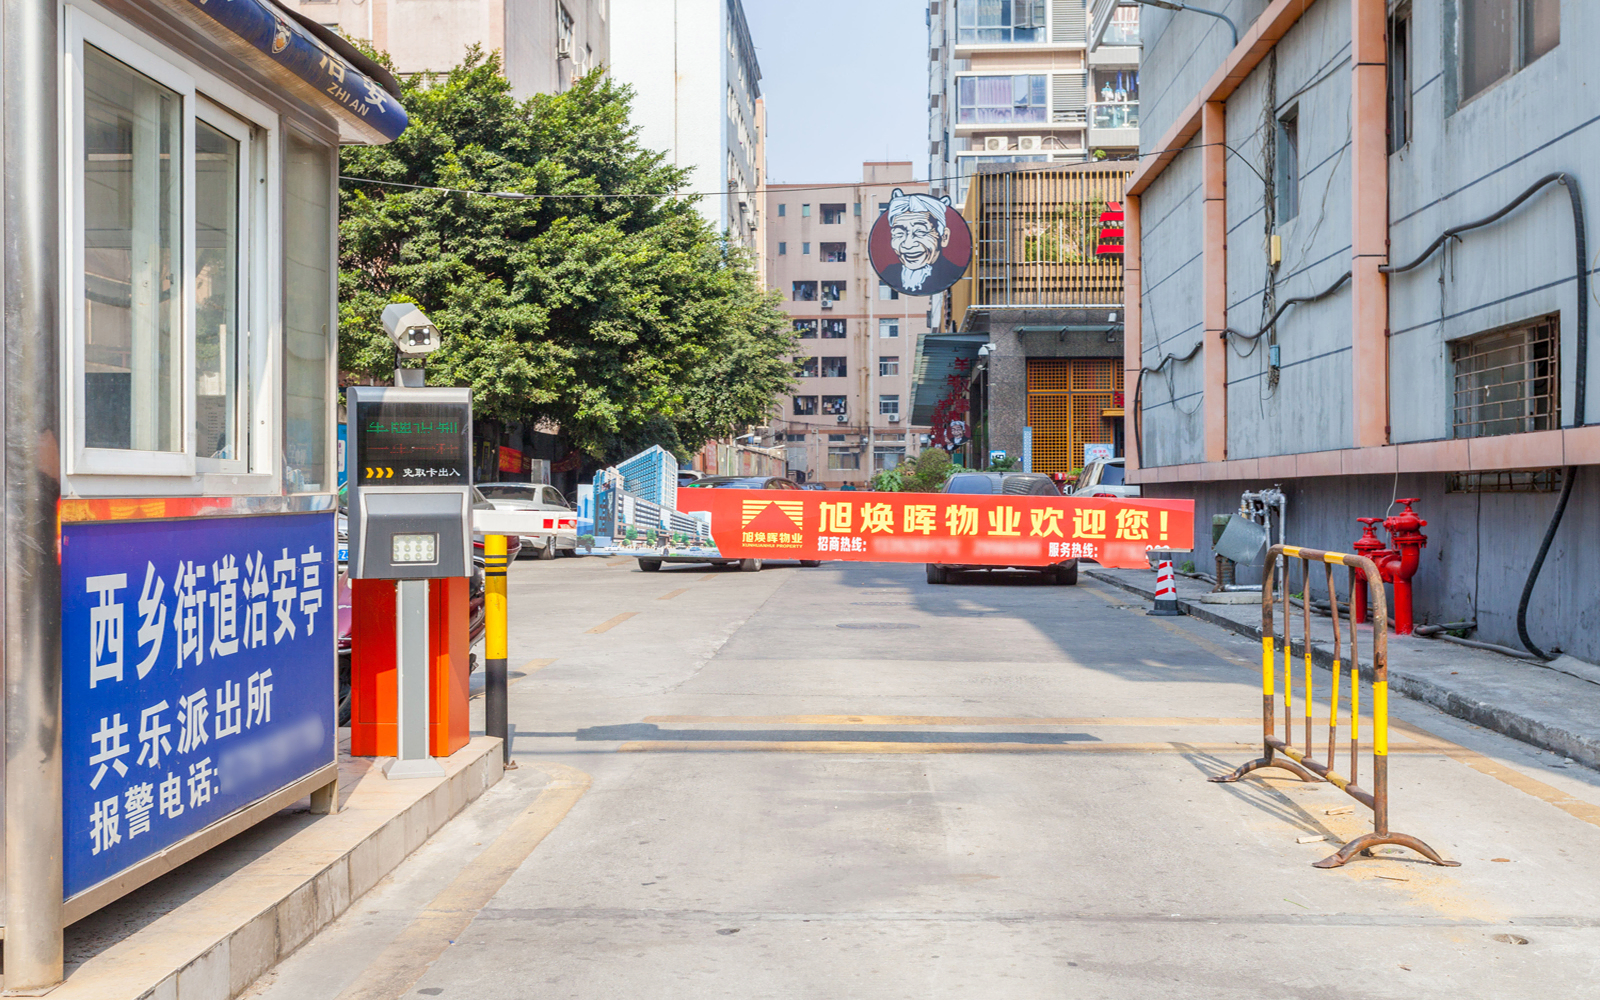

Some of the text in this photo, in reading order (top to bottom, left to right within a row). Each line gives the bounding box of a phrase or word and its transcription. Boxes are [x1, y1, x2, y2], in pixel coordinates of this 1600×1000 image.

[326, 82, 370, 117] ZHI AN
[402, 467, 461, 478] 免取卡出入
[741, 531, 803, 544] 旭焕晖物业
[818, 501, 1169, 541] 旭焕晖物业欢迎您!
[817, 536, 867, 552] 招商热线:
[1048, 542, 1098, 558] 服务热线:
[86, 545, 322, 689] 西乡街道治安亭
[89, 668, 273, 790] 共乐派出所
[89, 757, 219, 856] 报警电话:
